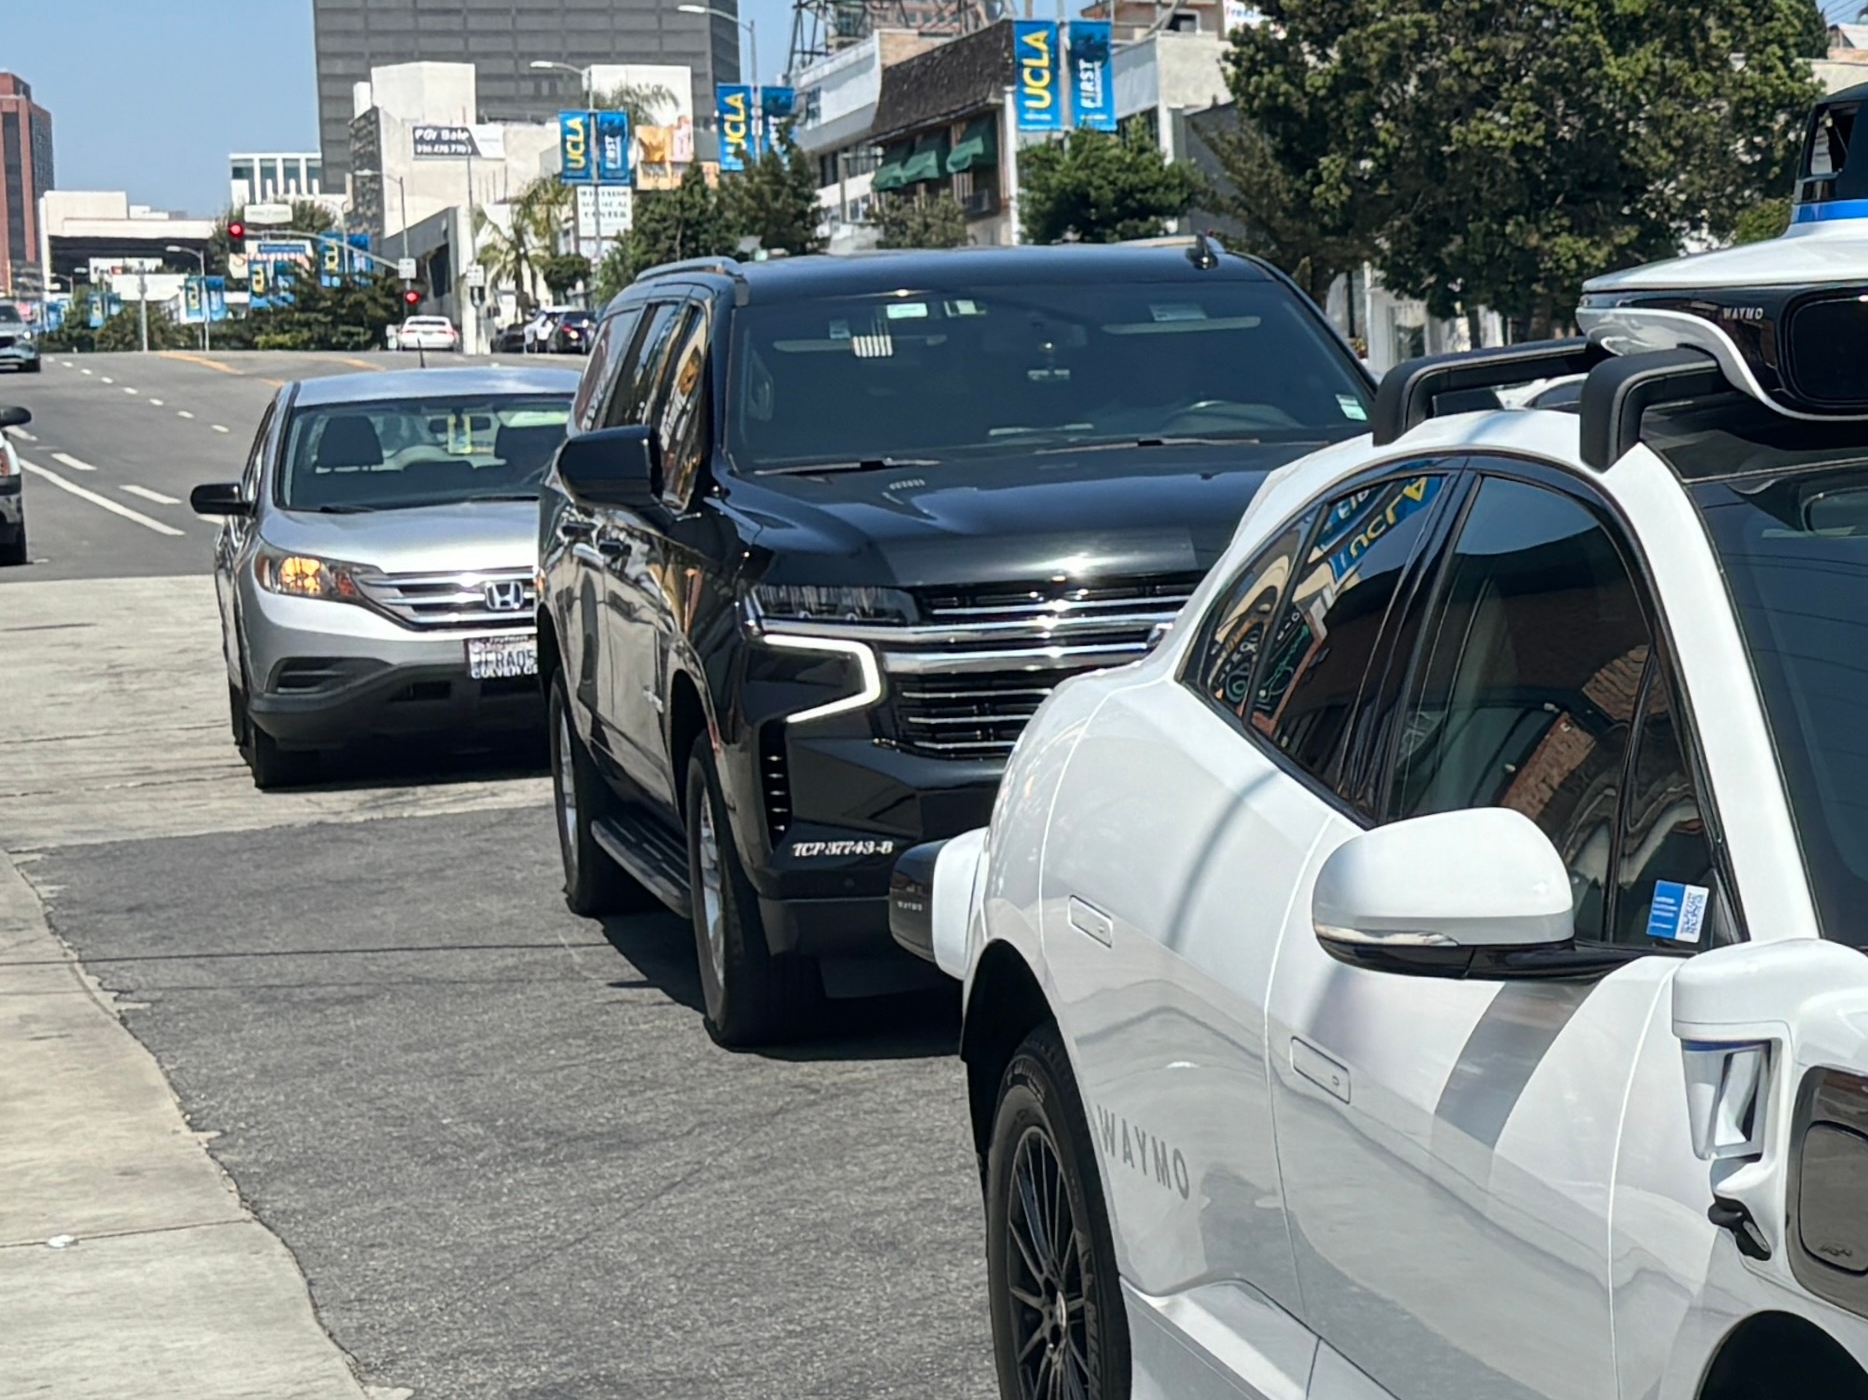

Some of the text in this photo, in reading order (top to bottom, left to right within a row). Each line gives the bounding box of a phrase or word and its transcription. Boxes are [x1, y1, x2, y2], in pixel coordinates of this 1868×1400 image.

[1022, 29, 1051, 110] UCLA
[566, 116, 586, 170] UCLA
[1723, 307, 1764, 320] WAYMO
[1097, 1103, 1190, 1201] WAYMO
